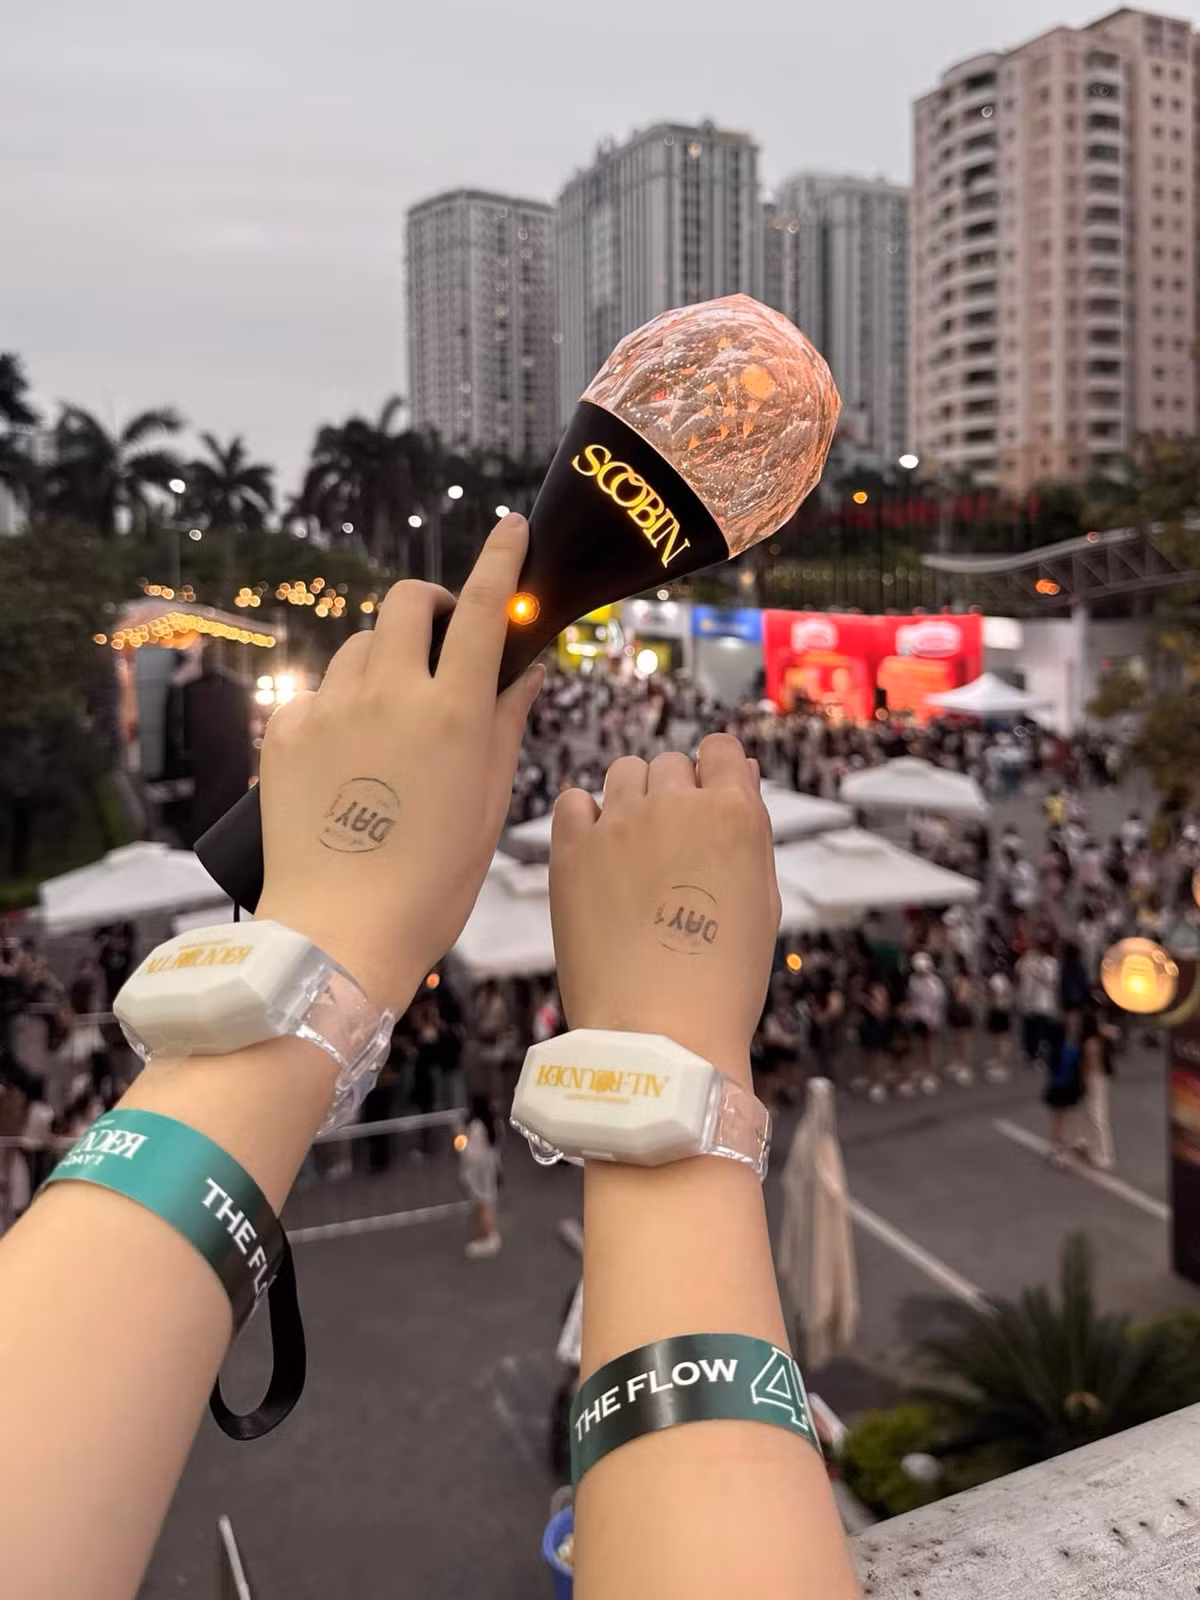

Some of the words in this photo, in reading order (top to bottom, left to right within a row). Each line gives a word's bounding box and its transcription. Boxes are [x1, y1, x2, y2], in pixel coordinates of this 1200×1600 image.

[572, 444, 691, 568] SOOBIN
[335, 801, 396, 843] DAY
[667, 906, 719, 944] DAY
[201, 1178, 257, 1254] THE
[248, 1245, 268, 1294] FL
[574, 1386, 621, 1442] THE
[626, 1359, 738, 1402] FLOW
